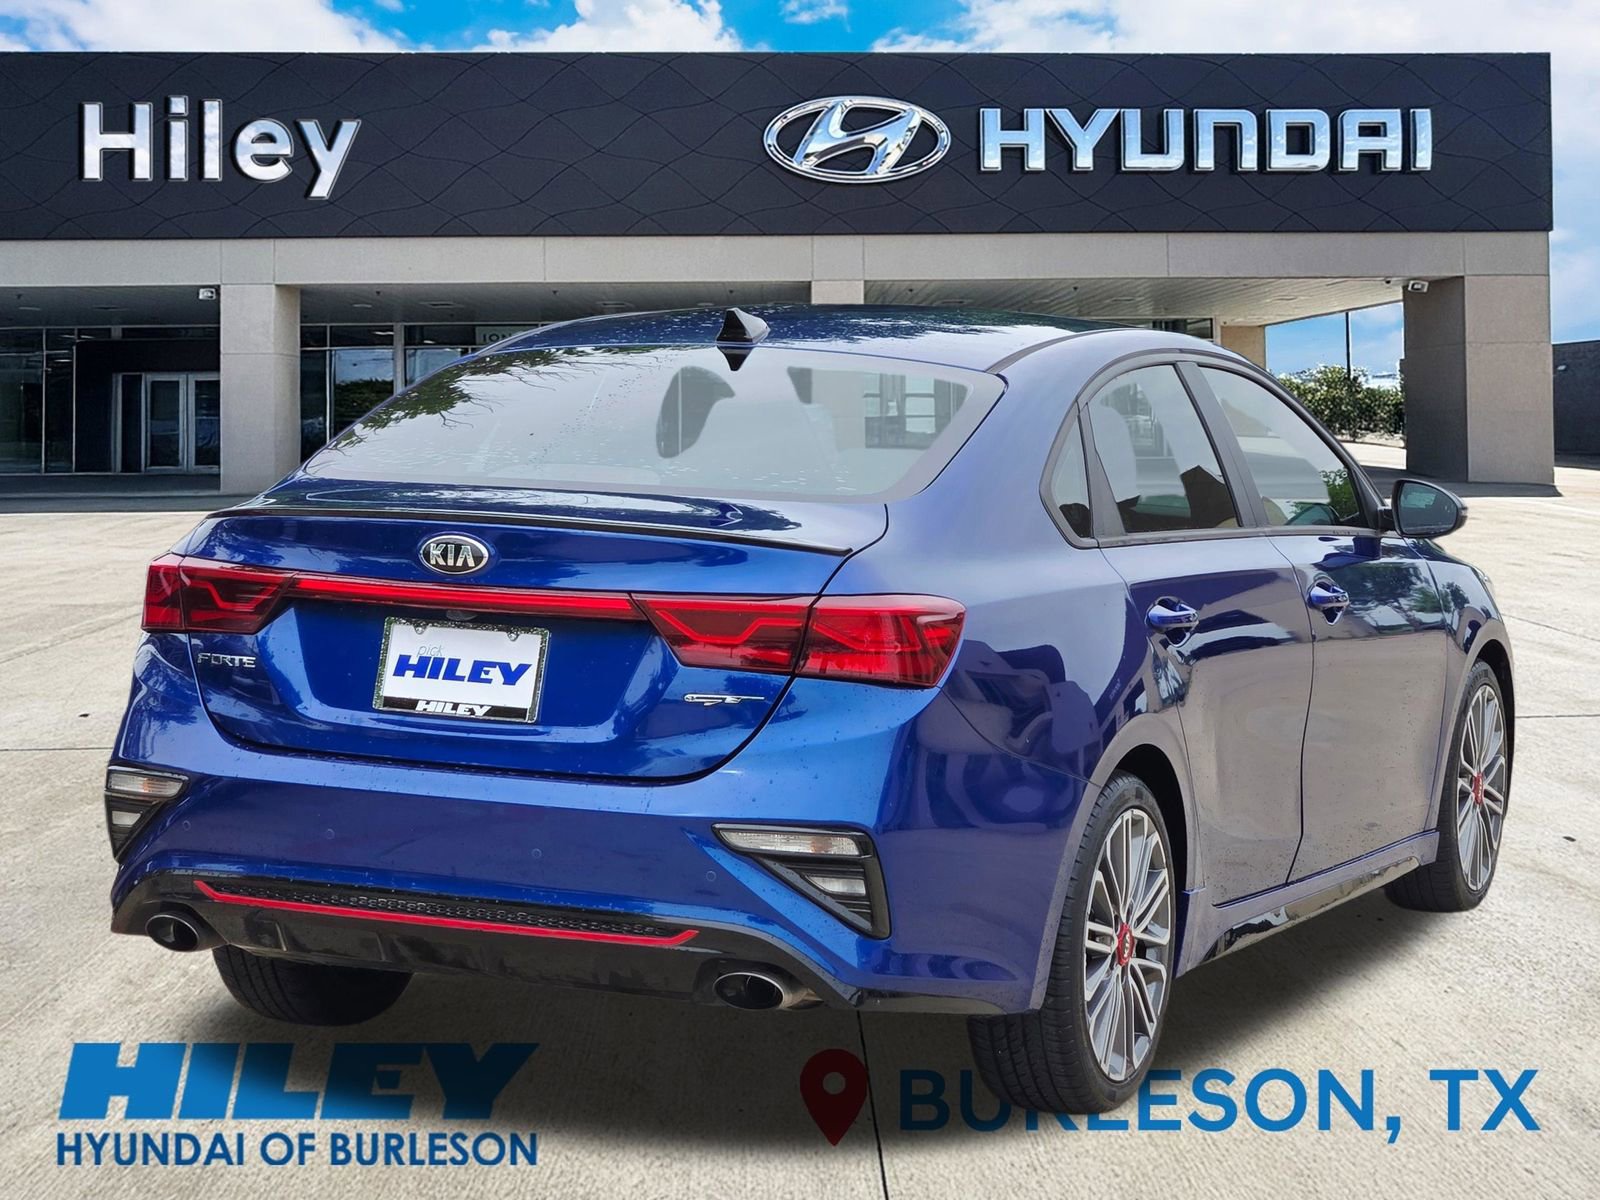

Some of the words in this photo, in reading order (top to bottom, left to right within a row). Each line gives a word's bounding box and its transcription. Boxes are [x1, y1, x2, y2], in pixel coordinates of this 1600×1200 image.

[80, 95, 361, 199] Hiley
[979, 108, 1433, 172] HYUNDAI
[429, 543, 475, 567] KIA
[197, 652, 256, 668] FORTE
[416, 643, 445, 658] pick
[393, 654, 532, 686] HILEY
[415, 700, 492, 717] HILEY
